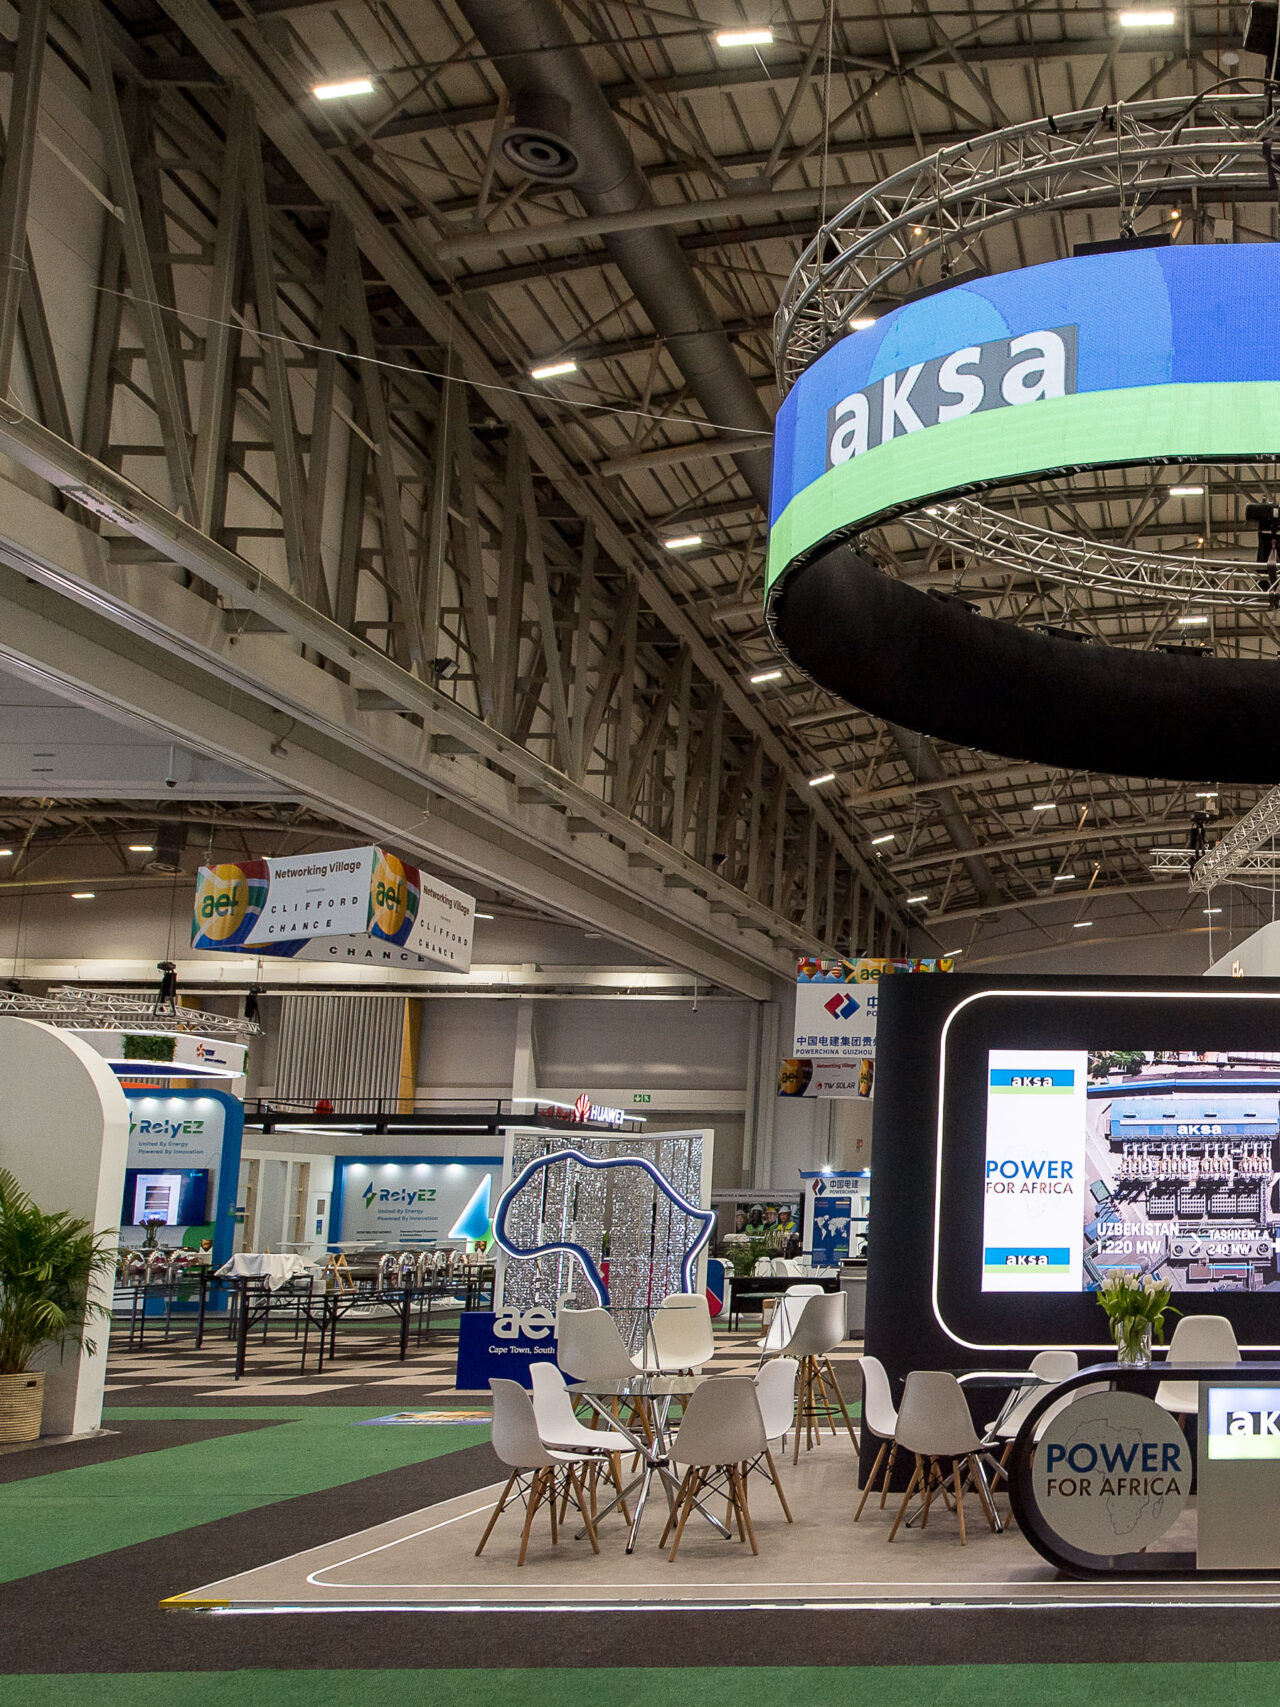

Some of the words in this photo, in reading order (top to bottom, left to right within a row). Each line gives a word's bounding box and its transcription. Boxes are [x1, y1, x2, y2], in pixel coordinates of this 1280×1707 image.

[829, 330, 1068, 467] aksa
[275, 865, 328, 879] Networking
[329, 861, 361, 873] Village
[201, 880, 241, 918] aef
[271, 896, 359, 914] CLIFFORD
[376, 880, 401, 913] aef
[423, 884, 453, 910] Networking
[453, 899, 470, 916] Village
[268, 919, 333, 933] CHANCE
[420, 919, 468, 946] CLIFFORD
[329, 946, 425, 963] CHANCE
[418, 939, 454, 960] CHANCE
[1012, 1076, 1053, 1087] aksa
[590, 1104, 624, 1124] HUAWEI
[140, 1119, 204, 1138] RelyEZ
[1177, 1125, 1222, 1135] aksa
[986, 1160, 1074, 1179] POWER
[830, 1180, 858, 1188] 中国电建
[986, 1182, 1015, 1194] FOR
[1020, 1182, 1073, 1194] AFRICA
[380, 1188, 437, 1205] RelyEZ
[1097, 1223, 1179, 1236] UZBEKISTAN
[1209, 1230, 1258, 1240] TASHKENT
[1261, 1230, 1269, 1240] A
[1097, 1240, 1132, 1254] 1.220
[1137, 1240, 1161, 1254] MW
[1209, 1244, 1229, 1254] 240
[1232, 1244, 1251, 1254] MW
[1007, 1254, 1048, 1265] aksa
[488, 1346, 508, 1355] Cape
[509, 1346, 532, 1355] Town,
[1046, 1443, 1182, 1473] POWER
[1047, 1478, 1092, 1497] FOR
[1099, 1477, 1181, 1496] AFRICA
